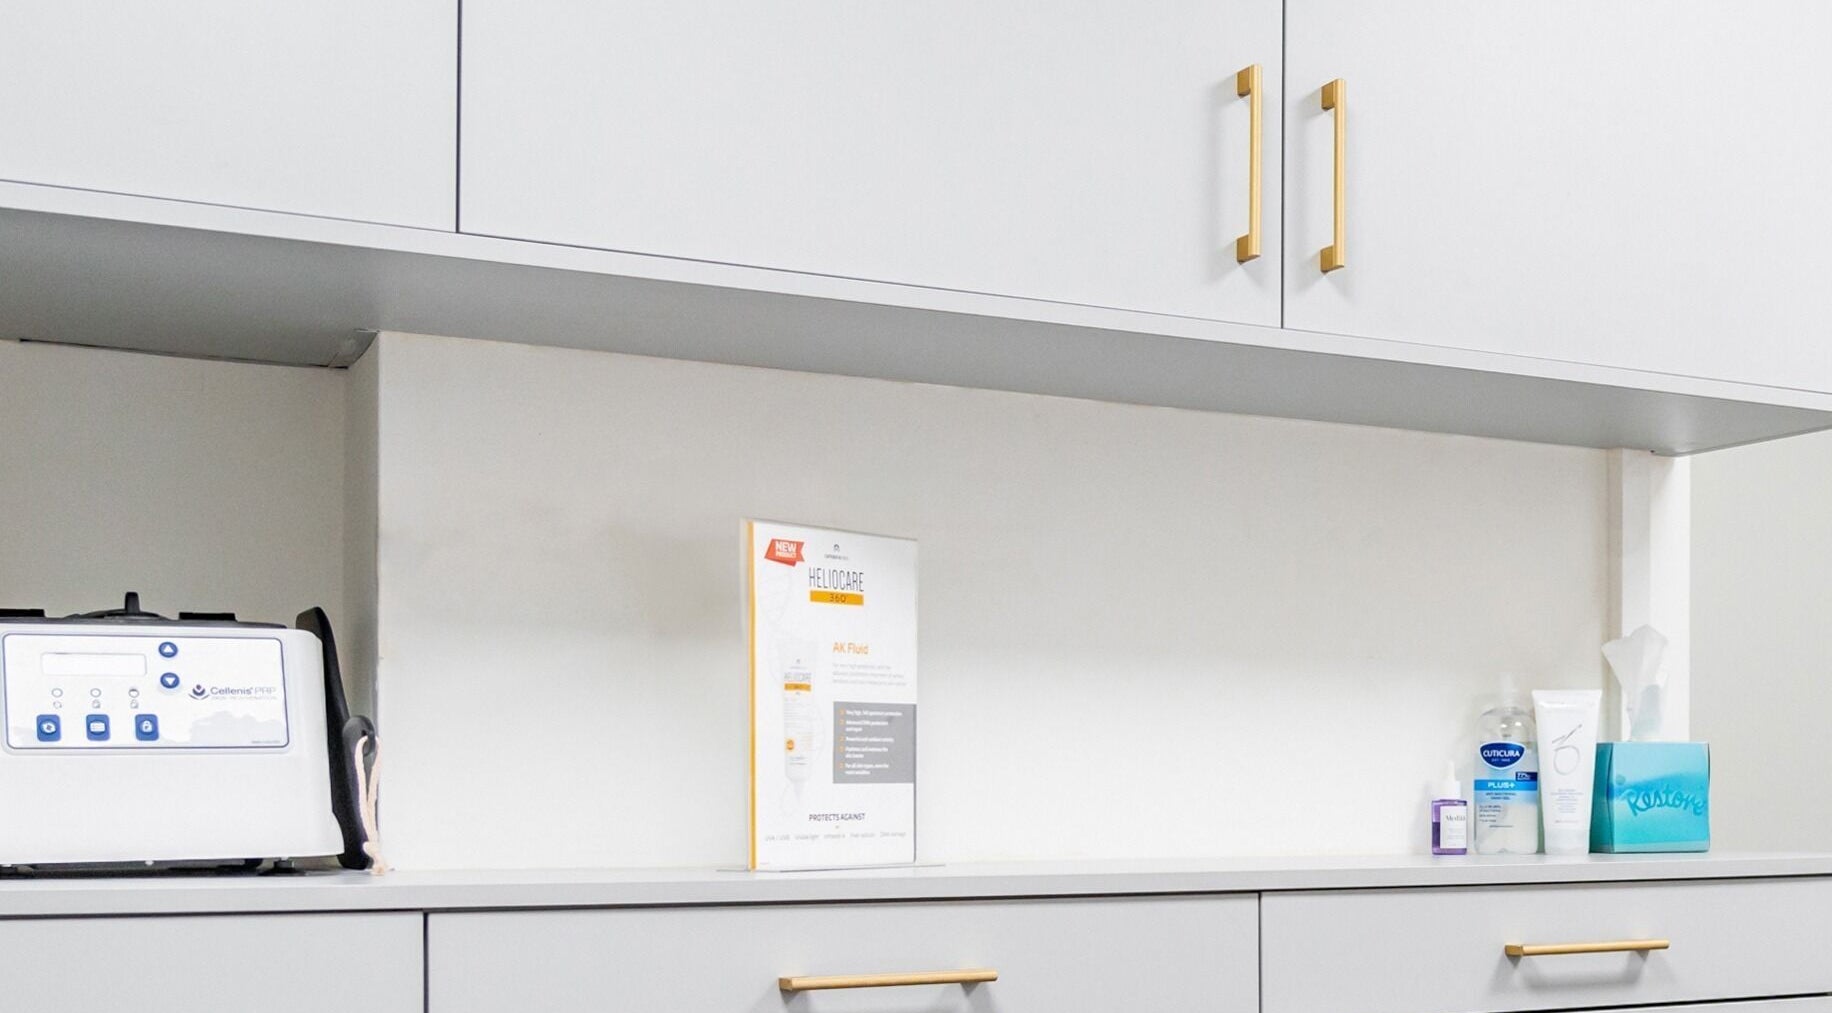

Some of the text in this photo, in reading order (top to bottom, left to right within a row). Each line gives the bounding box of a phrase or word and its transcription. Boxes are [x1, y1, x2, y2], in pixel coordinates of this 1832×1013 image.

[776, 541, 797, 553] NEW
[809, 567, 864, 592] HELIOCARE
[1483, 749, 1520, 758] CUTICURA
[1619, 784, 1707, 817] Restore
[809, 812, 866, 821] PROTECTS AGAINST
